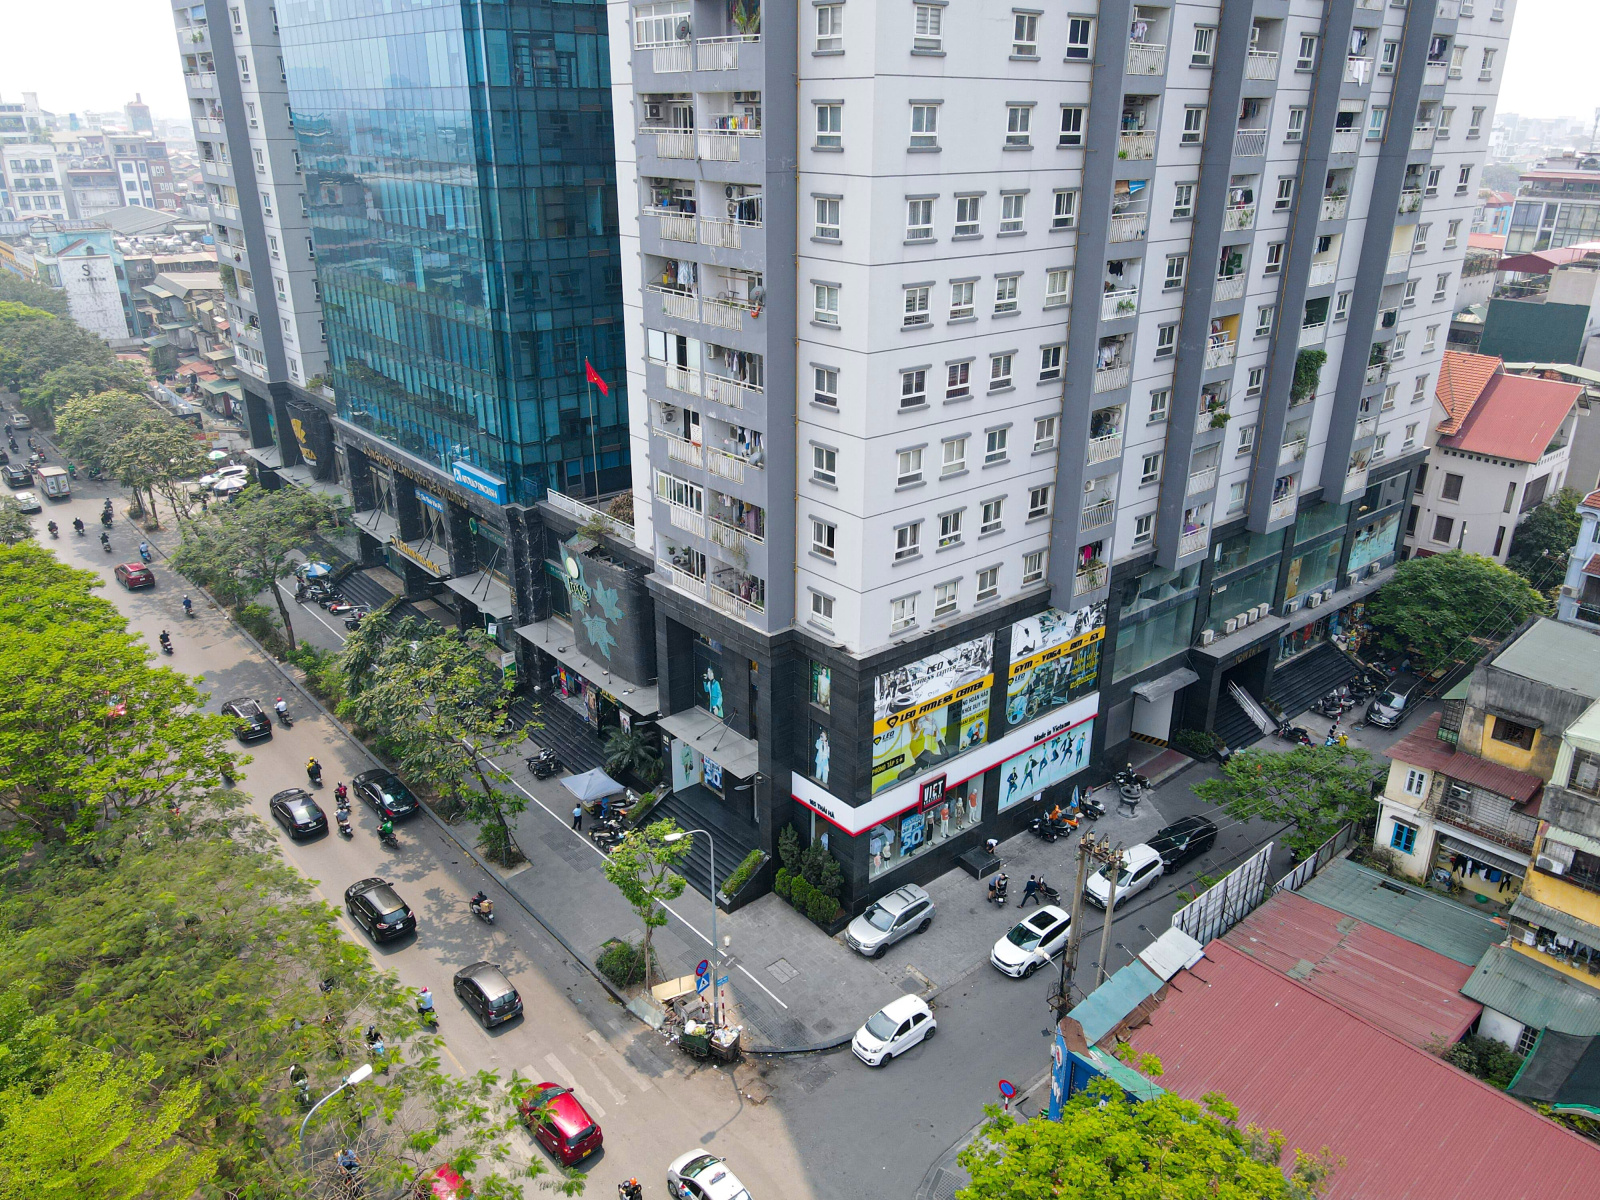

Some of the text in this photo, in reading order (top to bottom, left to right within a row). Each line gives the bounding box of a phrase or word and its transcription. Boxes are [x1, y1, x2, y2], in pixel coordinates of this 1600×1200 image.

[926, 661, 943, 675] LEO
[1014, 660, 1033, 674] GYM
[1041, 649, 1061, 662] YOGA
[900, 709, 916, 722] LEO
[918, 693, 954, 715] FITNESS
[955, 680, 984, 699] CENTER
[882, 730, 895, 740] LEO
